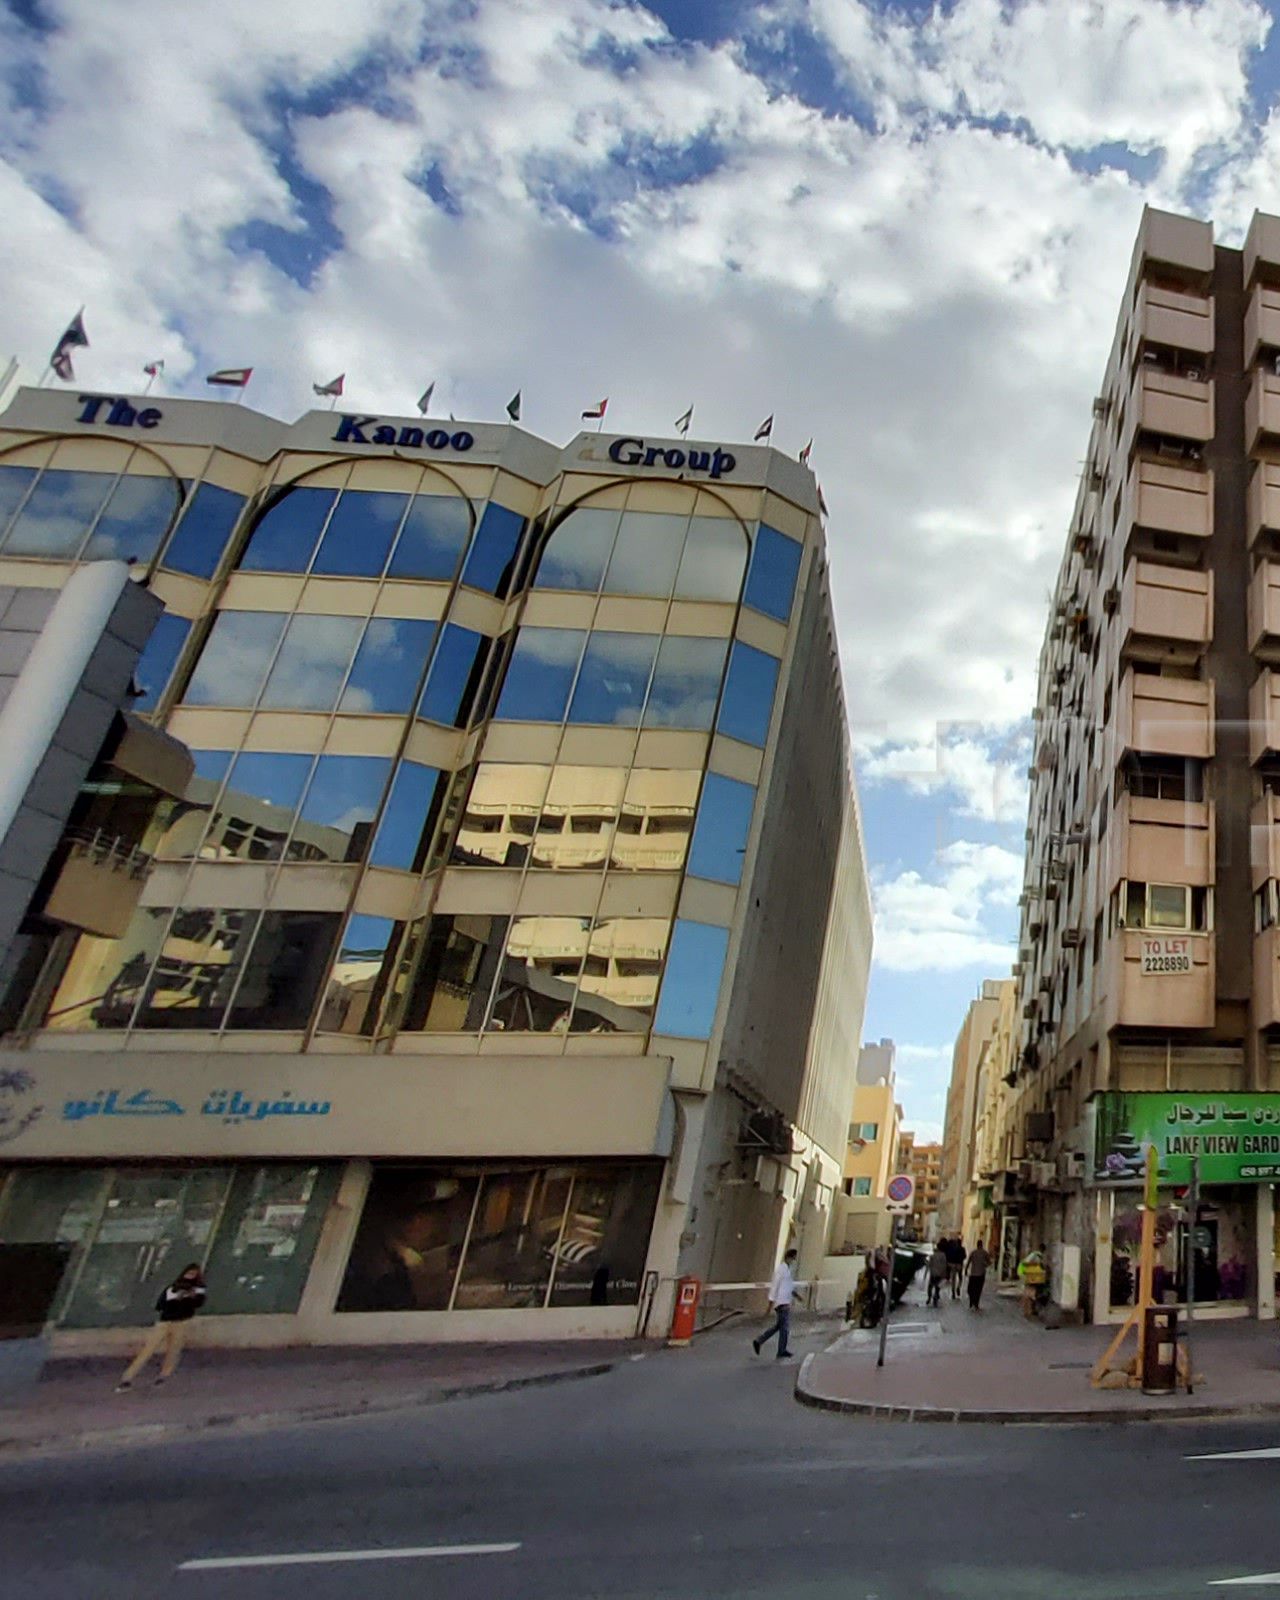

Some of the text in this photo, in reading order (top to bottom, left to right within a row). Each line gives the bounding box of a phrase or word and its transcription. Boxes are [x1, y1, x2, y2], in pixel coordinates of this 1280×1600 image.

[77, 395, 736, 479] The Kanoo Group
[1144, 940, 1188, 954] TO LET
[1145, 956, 1189, 972] 2228890
[61, 1089, 332, 1125] سفريات كانو
[1166, 1103, 1216, 1126] للرجال
[1165, 1136, 1200, 1155] LAKE
[1203, 1136, 1240, 1154] VIEW
